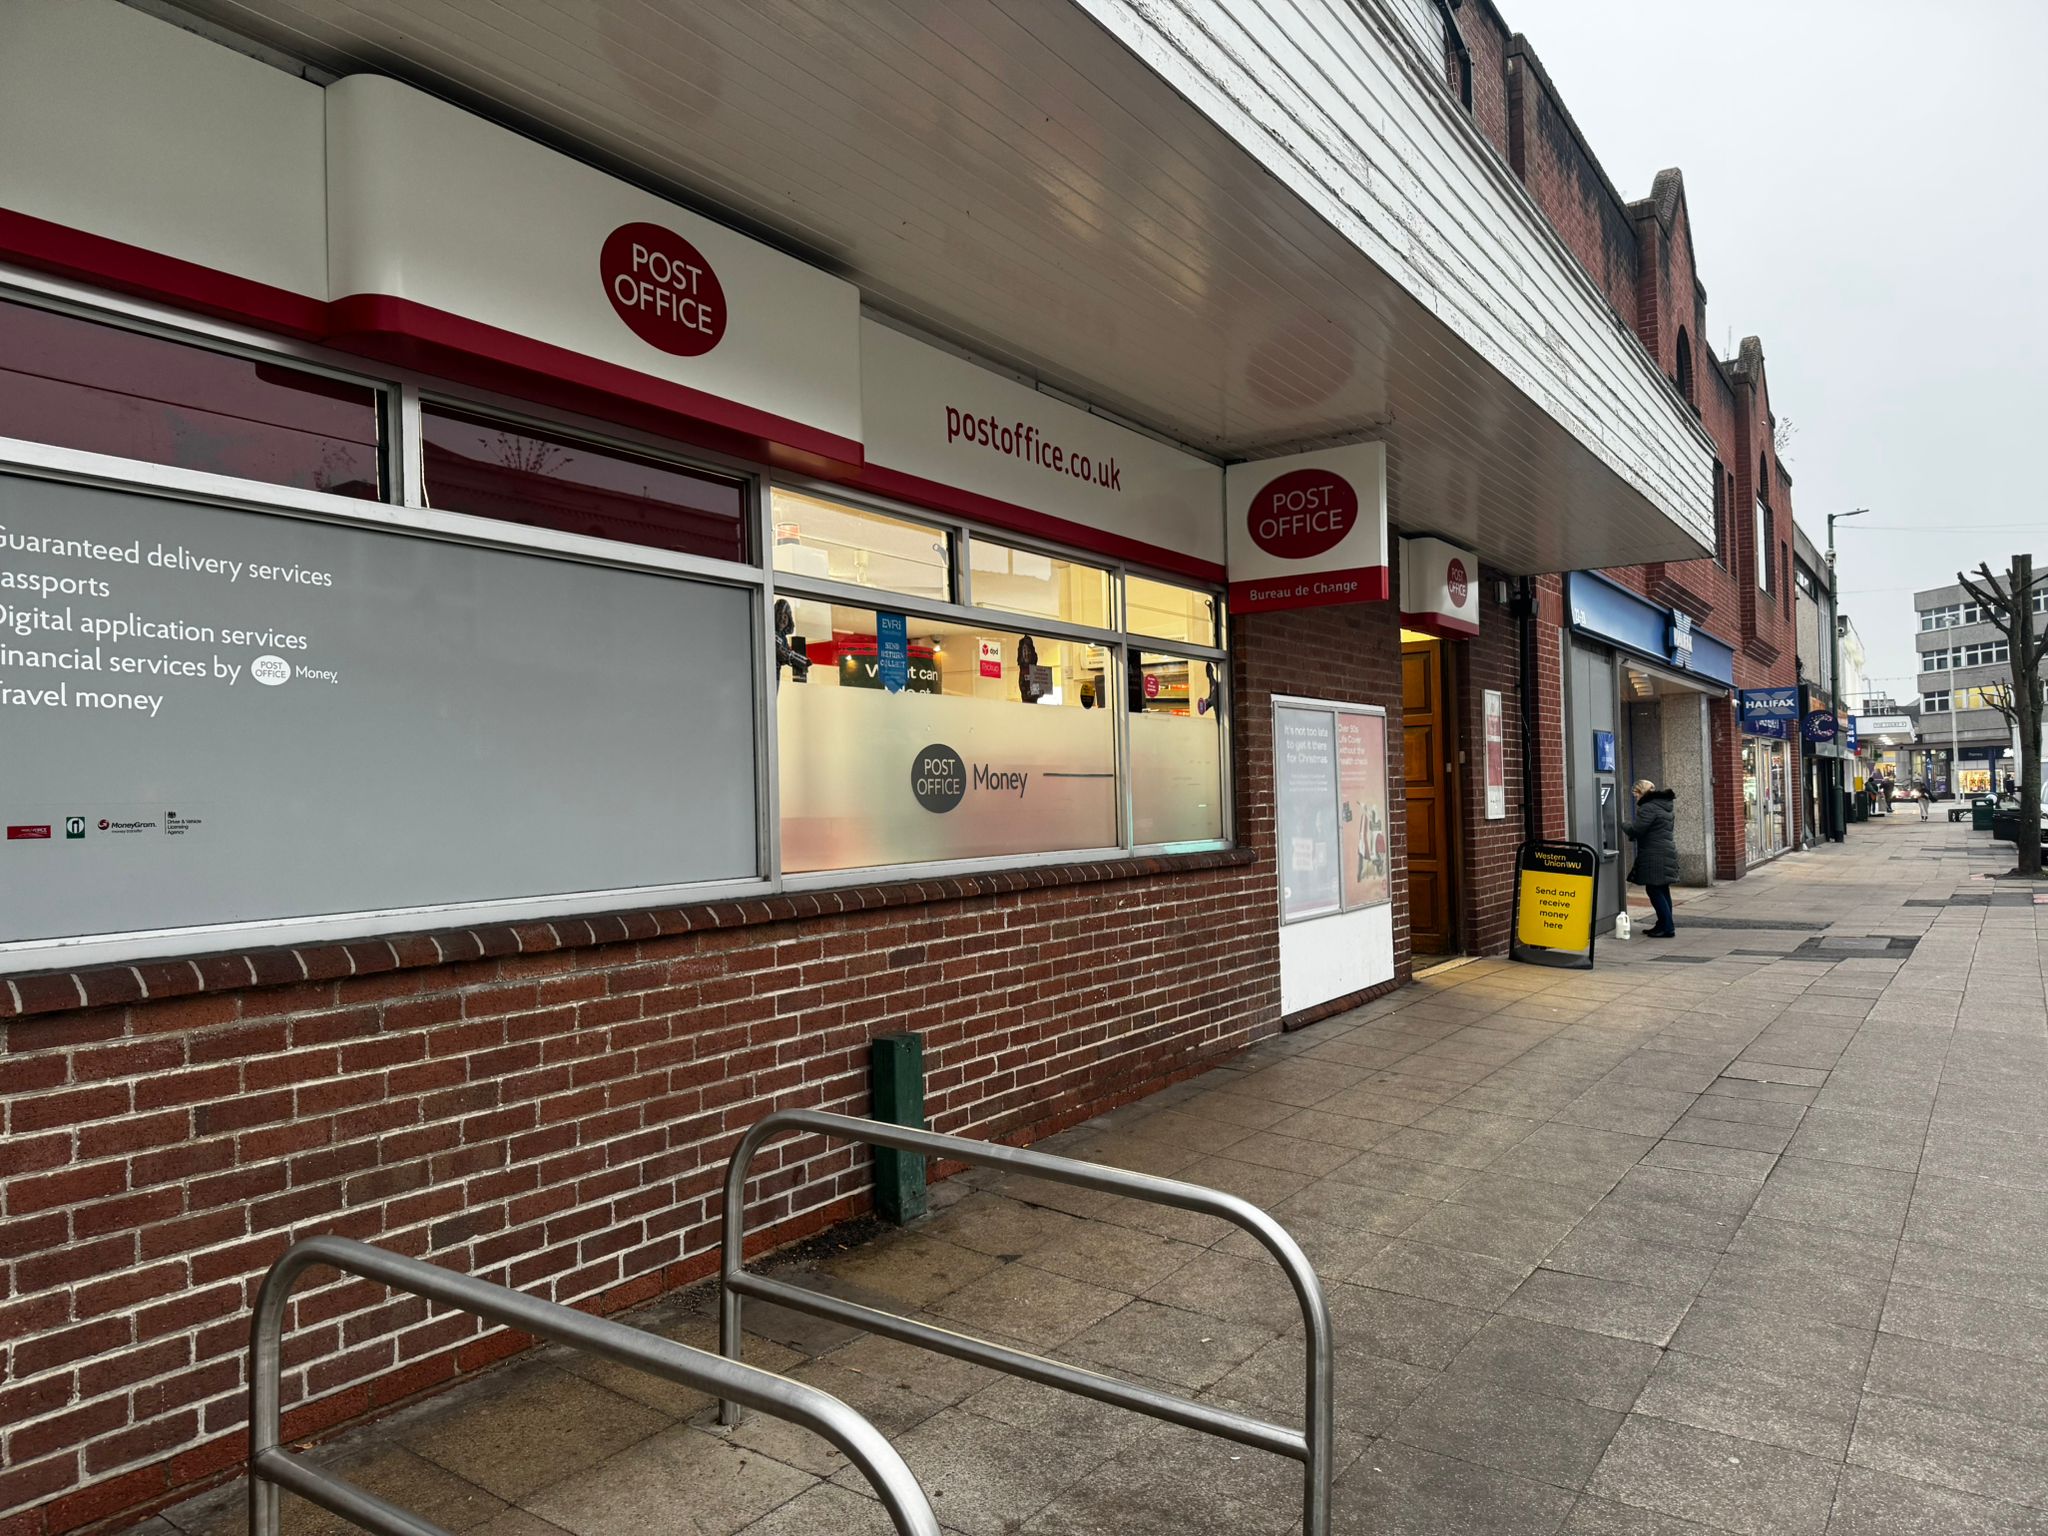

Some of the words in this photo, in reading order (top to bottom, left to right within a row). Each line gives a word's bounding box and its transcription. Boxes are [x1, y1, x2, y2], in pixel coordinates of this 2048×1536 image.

[631, 242, 702, 295] POST
[614, 274, 714, 335] OFFICE
[945, 405, 1121, 492] postoffice.co.uk
[1273, 485, 1333, 514] POST
[1258, 509, 1343, 540] OFFICE
[147, 544, 243, 582] delivery
[249, 563, 332, 587] services
[1451, 567, 1465, 581] POST
[0, 571, 110, 599] assports
[1250, 587, 1291, 601] Bureau
[1295, 585, 1309, 596] de
[1313, 580, 1358, 595] Change
[1449, 580, 1466, 597] OFFICE
[80, 612, 215, 642] application
[221, 628, 308, 650] services
[0, 644, 102, 671] inancial
[109, 654, 207, 677] services
[213, 655, 242, 685] by
[260, 661, 282, 670] POST
[255, 669, 286, 679] OFFICE
[918, 669, 938, 681] can
[0, 681, 67, 707] ravel
[75, 691, 164, 718] money
[1745, 698, 1795, 709] HALIFAX
[923, 758, 955, 776] POST
[916, 777, 960, 796] OFFICE
[973, 763, 1028, 798] Money
[1535, 852, 1566, 860] Western
[1544, 860, 1566, 868] Union
[1536, 886, 1556, 895] Send
[1539, 899, 1570, 908] receive
[1540, 910, 1569, 920] money
[1543, 920, 1563, 929] here
